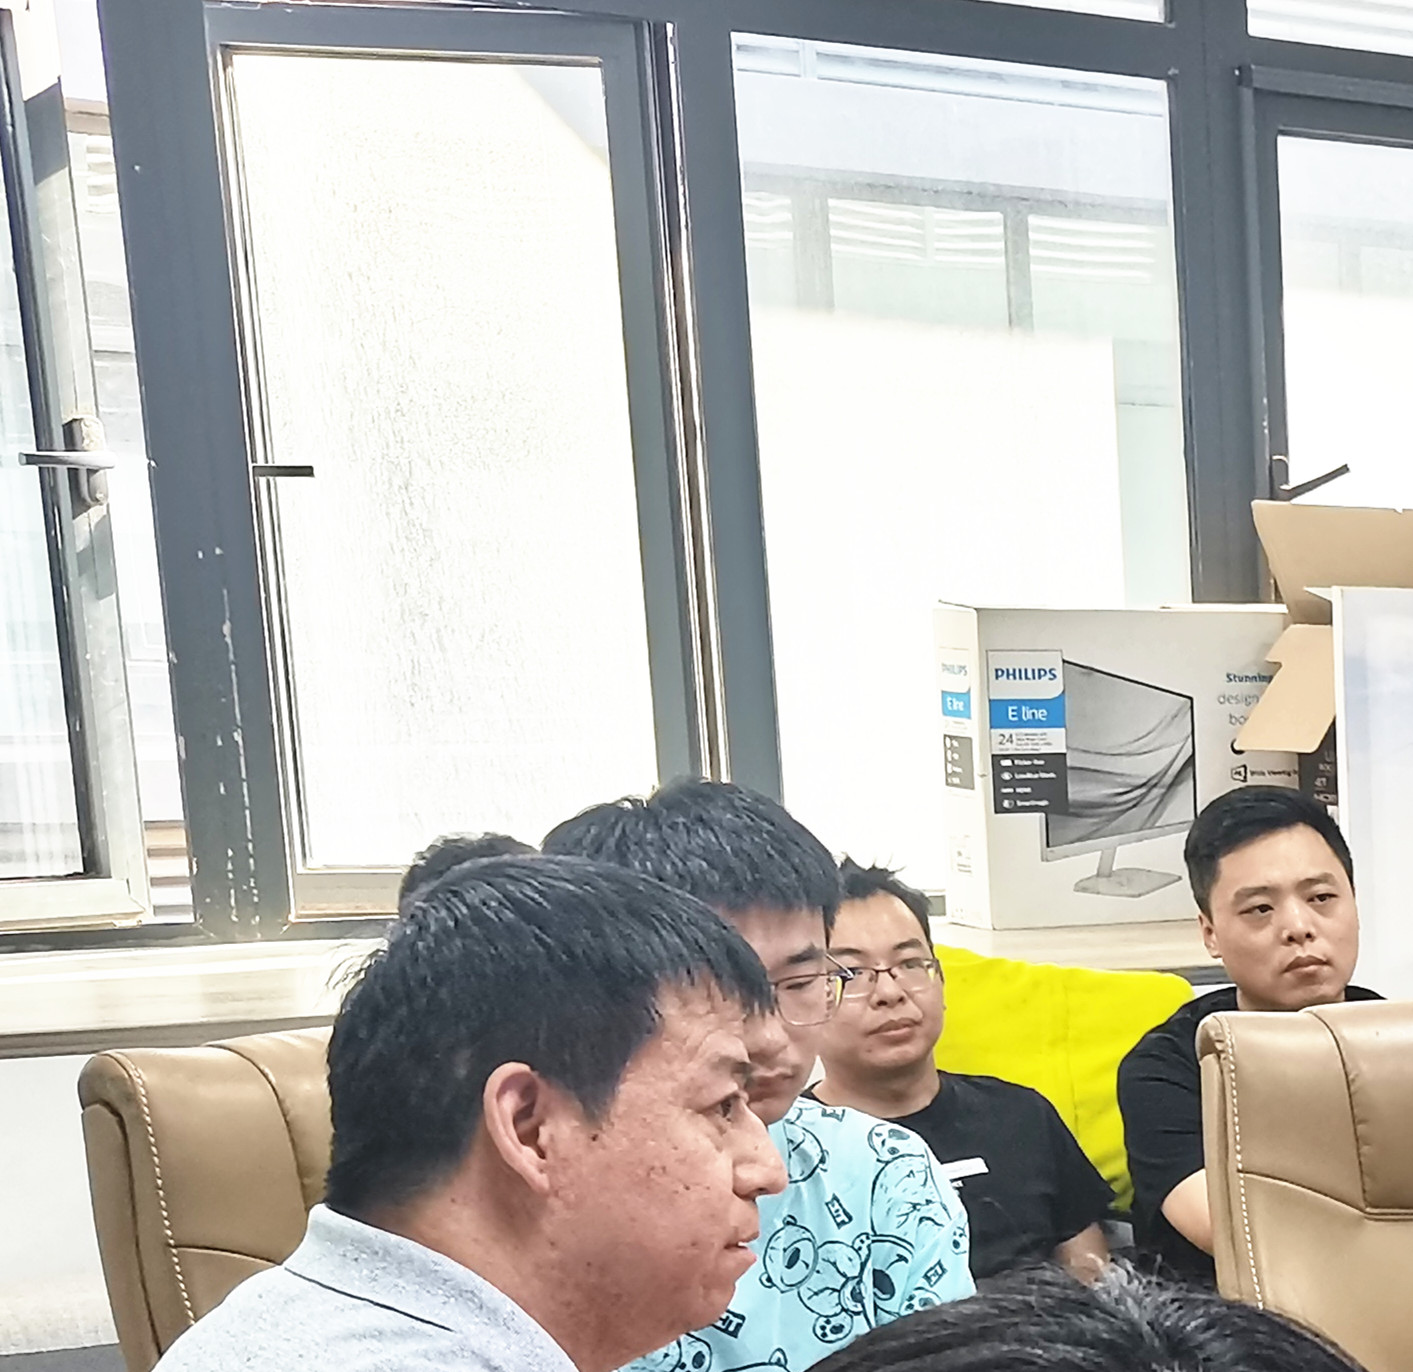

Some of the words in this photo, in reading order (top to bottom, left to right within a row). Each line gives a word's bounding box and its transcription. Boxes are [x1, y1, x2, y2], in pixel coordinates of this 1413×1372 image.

[994, 667, 1058, 680] PHILIPS
[1007, 705, 1019, 721] E
[1021, 705, 1048, 721] line
[998, 733, 1014, 745] 24
